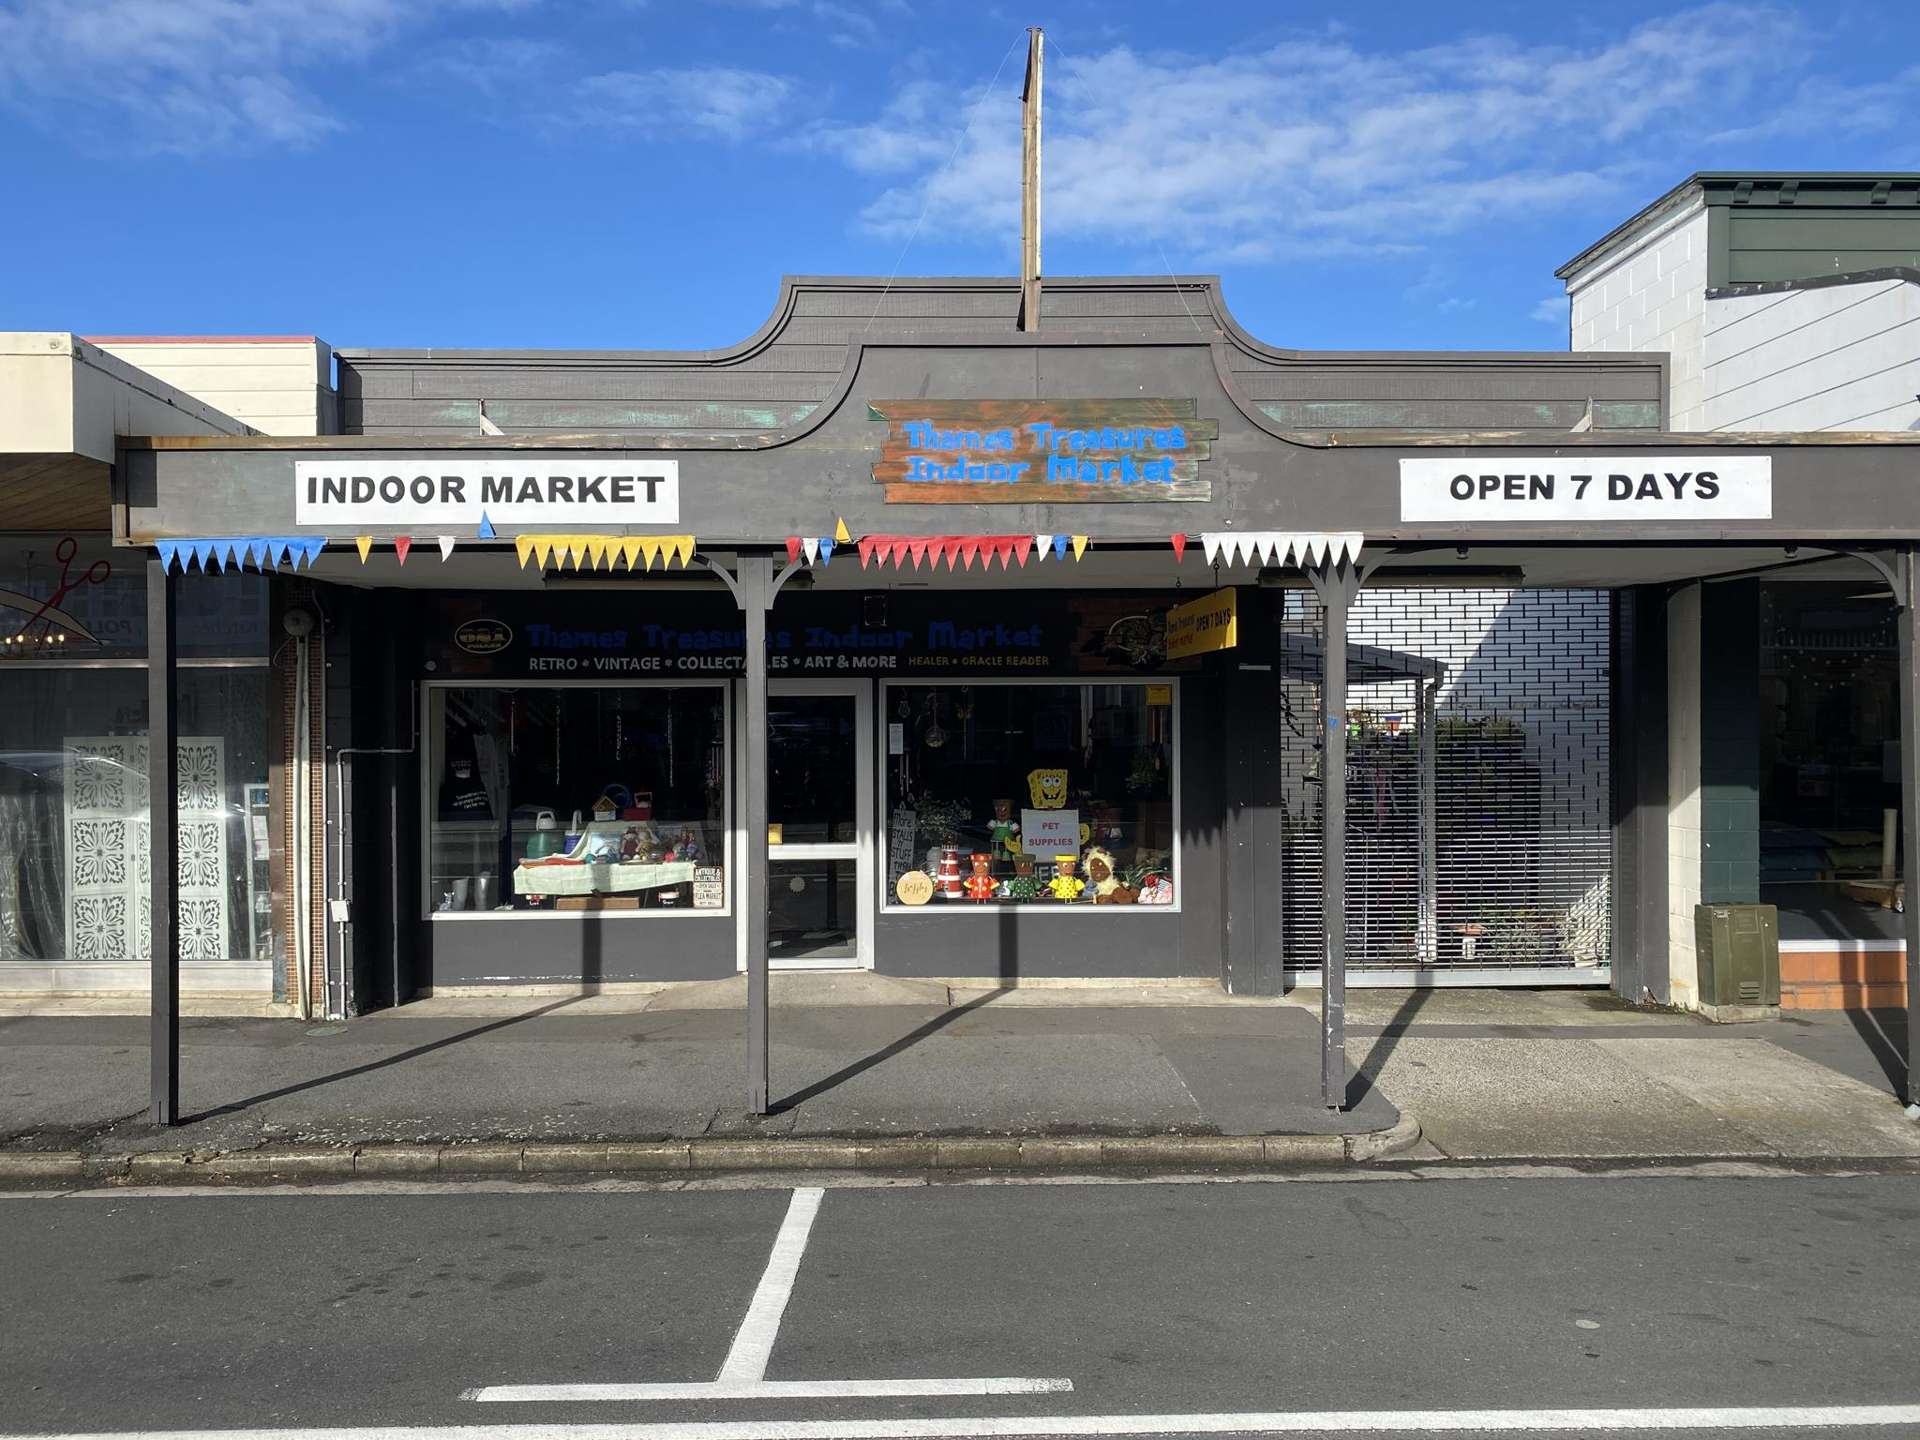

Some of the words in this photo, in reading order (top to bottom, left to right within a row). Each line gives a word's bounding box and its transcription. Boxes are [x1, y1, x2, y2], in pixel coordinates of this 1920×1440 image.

[903, 419, 1014, 451] Thames
[1028, 421, 1187, 451] Treasures
[904, 455, 1031, 484] Indoor
[1047, 454, 1178, 484] Market
[307, 475, 466, 504] INDOOR
[480, 476, 665, 503] MARKET
[1450, 474, 1555, 500] OPEN
[1570, 475, 1593, 500] 7
[1608, 471, 1720, 500] DAYS
[525, 624, 628, 648] Thames
[639, 623, 792, 650] Treasus
[804, 624, 912, 649] Indoor
[927, 621, 1042, 650] Market
[529, 657, 578, 671] RETRO
[593, 657, 661, 671] VINTAGE
[677, 656, 789, 670] COLLECTES
[804, 655, 834, 669] ART
[852, 655, 897, 669] MORE
[908, 656, 949, 666] HEALER
[961, 656, 1004, 666] ORACLE
[1006, 656, 1049, 666] READER
[1042, 822, 1060, 830] PET
[1029, 838, 1073, 846] SUPPLIES
